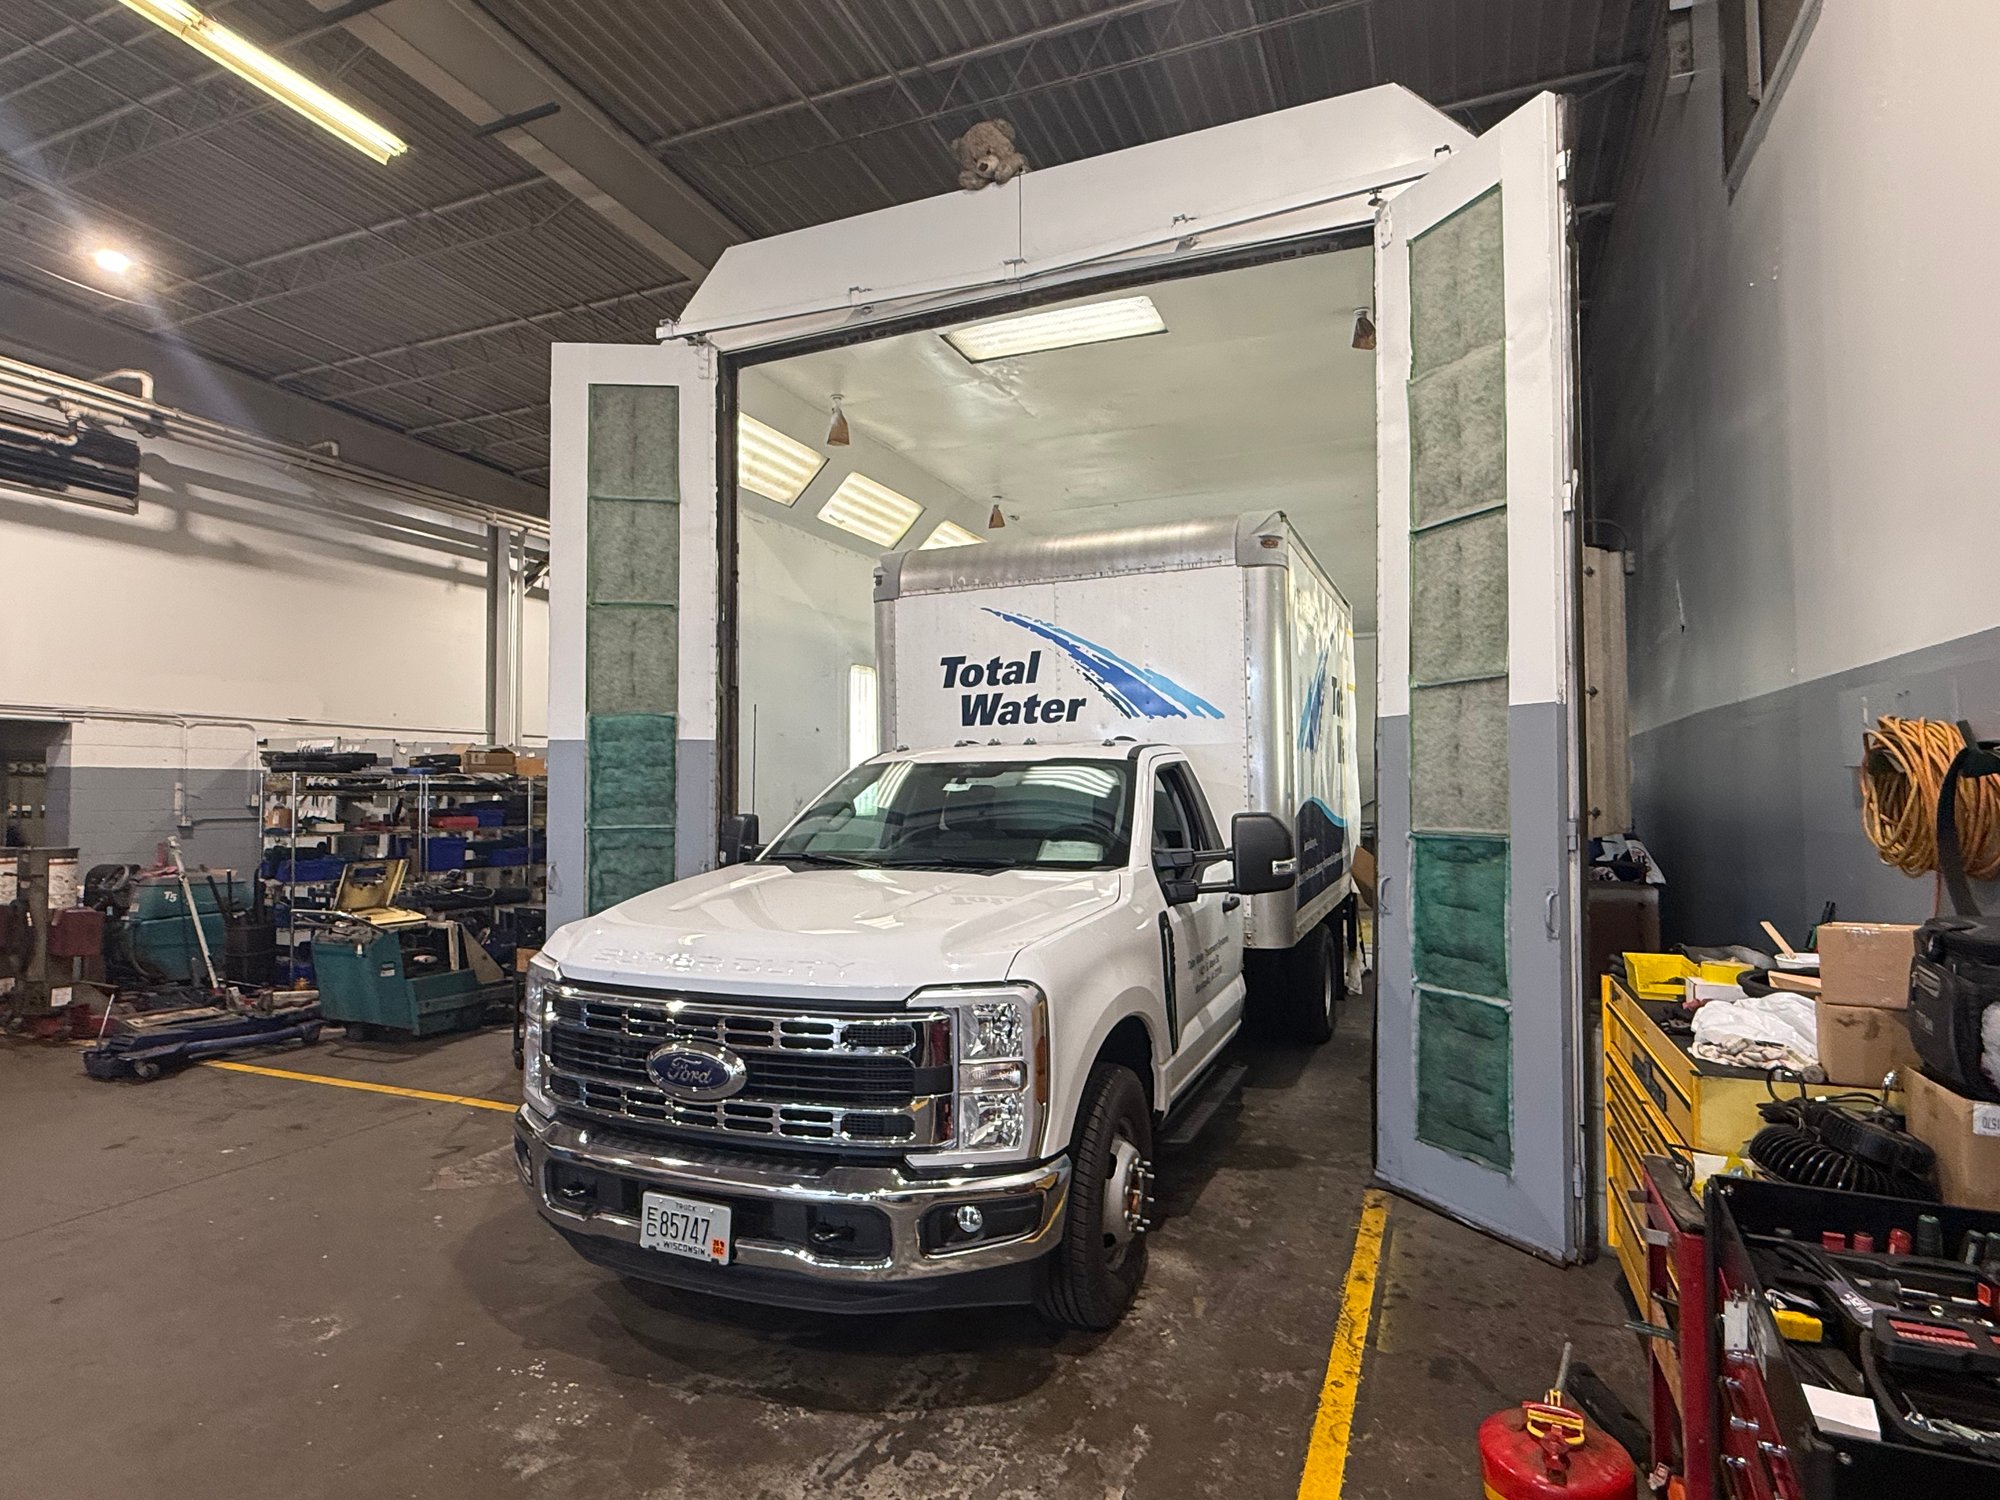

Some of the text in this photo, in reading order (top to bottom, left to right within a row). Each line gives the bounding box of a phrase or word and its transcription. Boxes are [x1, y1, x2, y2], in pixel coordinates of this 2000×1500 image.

[940, 650, 1042, 689] Total
[961, 692, 1088, 727] Water
[163, 890, 178, 903] T5
[667, 1056, 712, 1084] Ford
[659, 1210, 711, 1247] 85747
[663, 1240, 706, 1256] WISCONSIN
